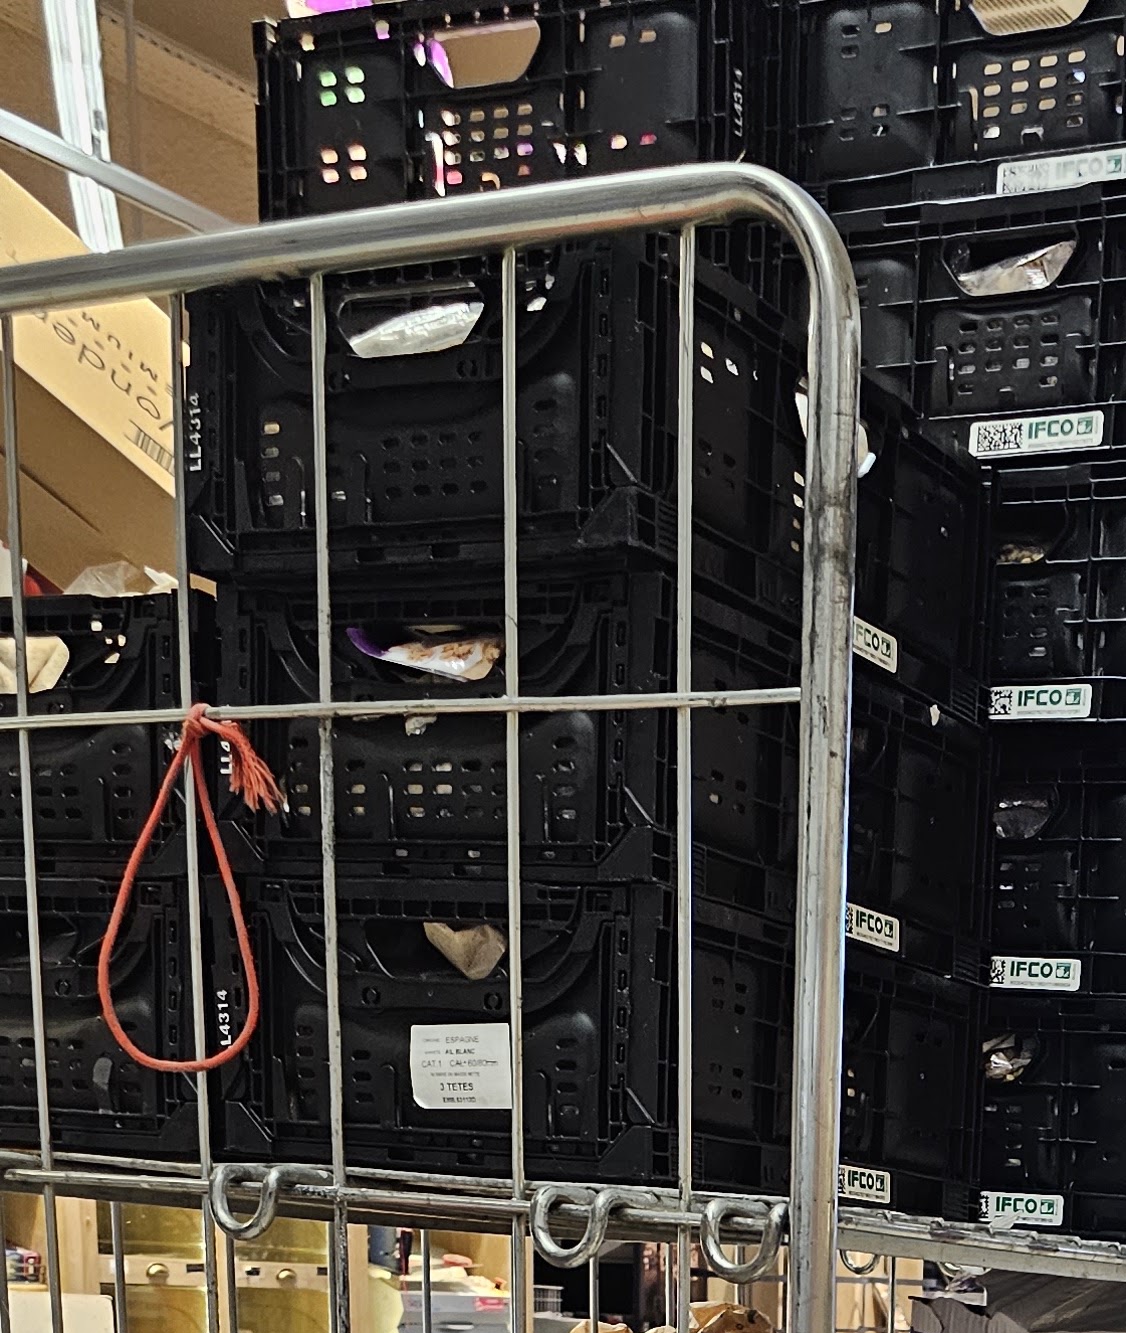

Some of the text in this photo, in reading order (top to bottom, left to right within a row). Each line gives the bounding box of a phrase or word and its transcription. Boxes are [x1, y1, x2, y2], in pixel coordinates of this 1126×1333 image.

[733, 66, 743, 138] LL4314
[189, 392, 201, 472] LL4314
[1027, 418, 1075, 440] IFCO
[854, 623, 880, 651] FCO
[1017, 689, 1063, 707] IFCO
[856, 909, 884, 935] IFCO
[1009, 960, 1054, 979] IFCO
[216, 989, 232, 1047] L4314
[447, 1082, 474, 1091] TETES
[848, 1169, 875, 1190] IFCO
[995, 1195, 1038, 1214] IFCO
